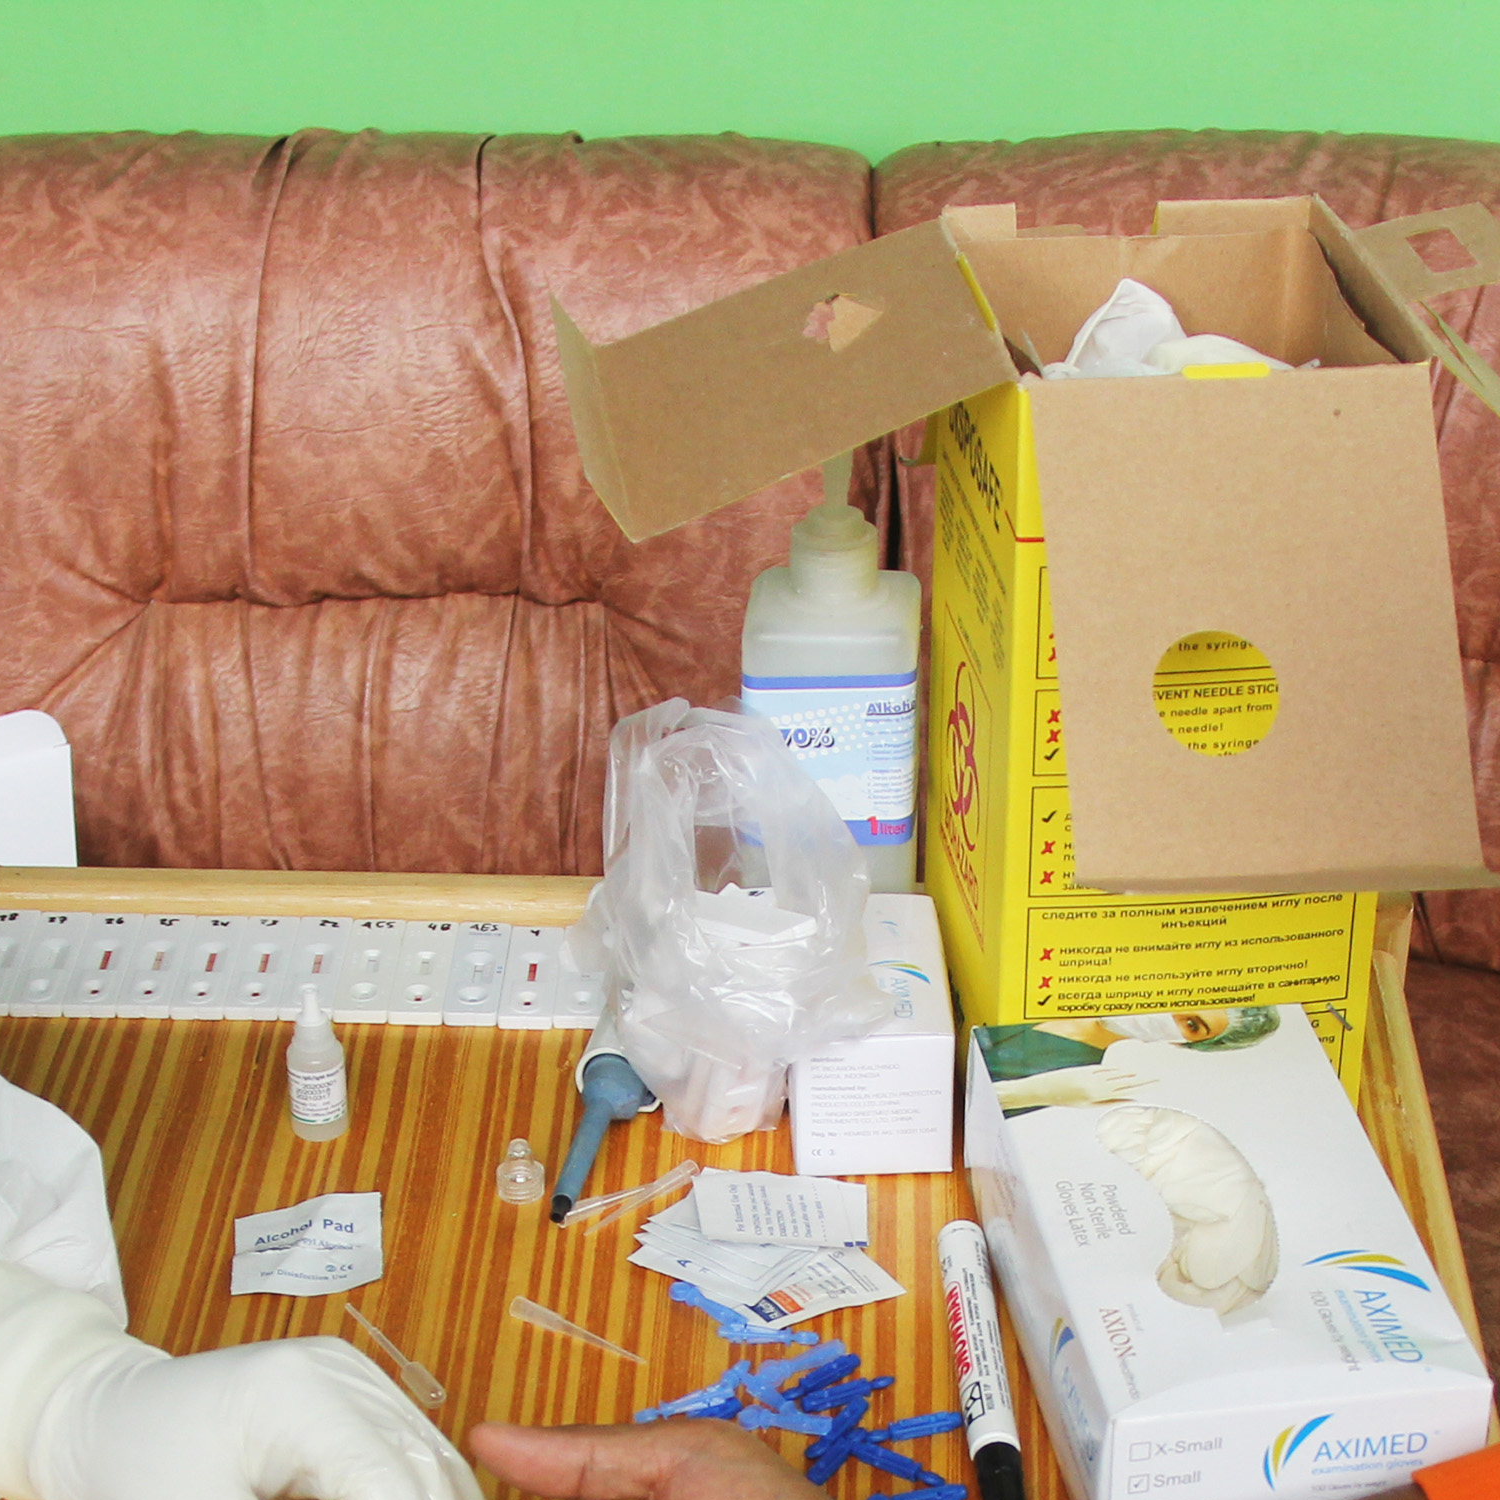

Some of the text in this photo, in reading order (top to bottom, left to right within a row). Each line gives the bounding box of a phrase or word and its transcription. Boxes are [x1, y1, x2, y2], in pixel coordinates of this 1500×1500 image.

[1178, 641, 1198, 651] the
[1194, 686, 1244, 698] NEEDLE
[1170, 706, 1208, 717] needle
[1213, 705, 1242, 715] apart
[1247, 702, 1273, 712] from
[779, 727, 835, 749] 70%
[1178, 723, 1224, 734] needle!
[1188, 739, 1260, 750] the syringe
[880, 822, 907, 836] liter
[1042, 893, 1343, 921] следите за полным извлечением иглу после
[105, 916, 125, 925] 26
[1161, 916, 1227, 929] инъекций
[1060, 946, 1112, 956] никогда
[1116, 945, 1130, 953] не
[1195, 939, 1222, 950] иглу
[1225, 938, 1238, 946] из
[1241, 927, 1344, 945] использованного
[1058, 960, 1308, 985] никогда не используйте иглу вторично!
[1059, 957, 1112, 969] шприца!
[1058, 991, 1102, 1001] всегда
[1105, 988, 1153, 999] шприцу
[1156, 988, 1164, 997] и
[1167, 986, 1194, 998] иглу
[1197, 981, 1265, 995] помещайте
[1055, 1180, 1091, 1248] Gloves Latex
[1078, 1182, 1111, 1240] Non Sterile
[1101, 1183, 1137, 1236] Powdered
[255, 1219, 313, 1247] Alcohol
[323, 1218, 354, 1234] Pad
[946, 1285, 972, 1384] SNOWMAN
[1099, 1307, 1137, 1359] AXION
[1353, 1289, 1423, 1363] AXIMED
[1155, 1437, 1222, 1456] X-Small
[1313, 1432, 1428, 1462] AXIMED
[1311, 1461, 1383, 1475] examination
[1153, 1471, 1201, 1488] Small
